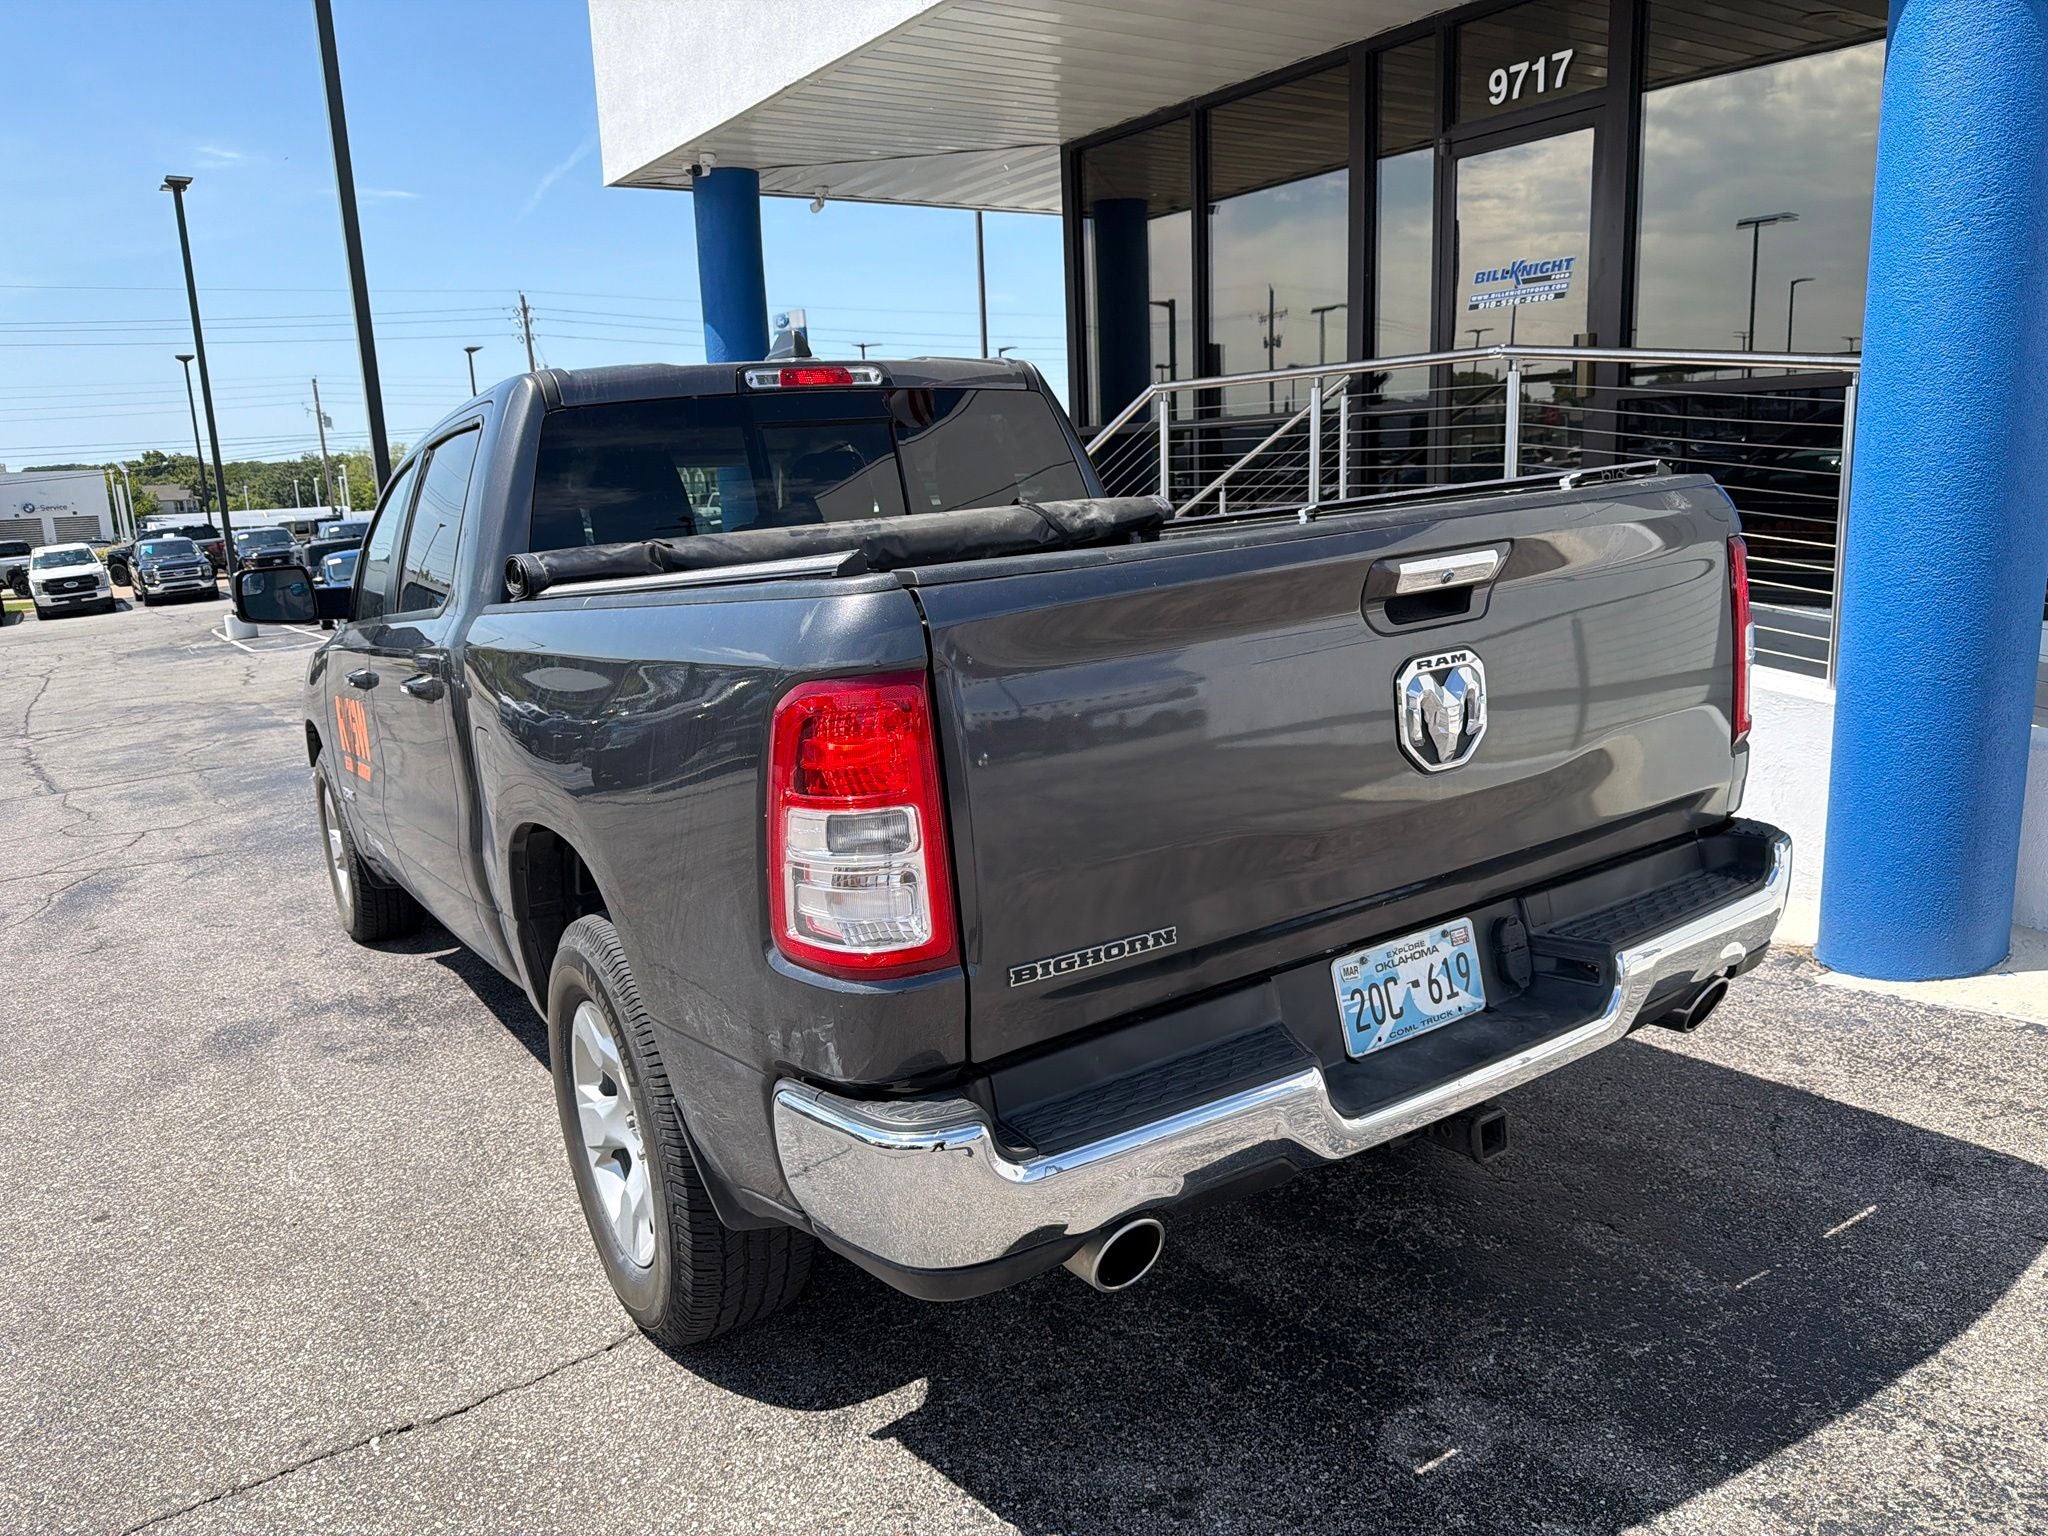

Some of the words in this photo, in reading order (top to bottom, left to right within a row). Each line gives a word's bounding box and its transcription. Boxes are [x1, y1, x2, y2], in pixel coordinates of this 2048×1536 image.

[1488, 48, 1574, 106] 9717
[1550, 272, 1570, 280] FORD
[1416, 653, 1467, 670] RAM
[1009, 926, 1177, 987] BIGHORN
[1374, 944, 1440, 974] OKLAHOMA
[1386, 940, 1426, 959] EXPLORE
[1342, 965, 1359, 977] MAR
[1389, 1024, 1419, 1039] COML
[1420, 1009, 1454, 1027] TRUCK
